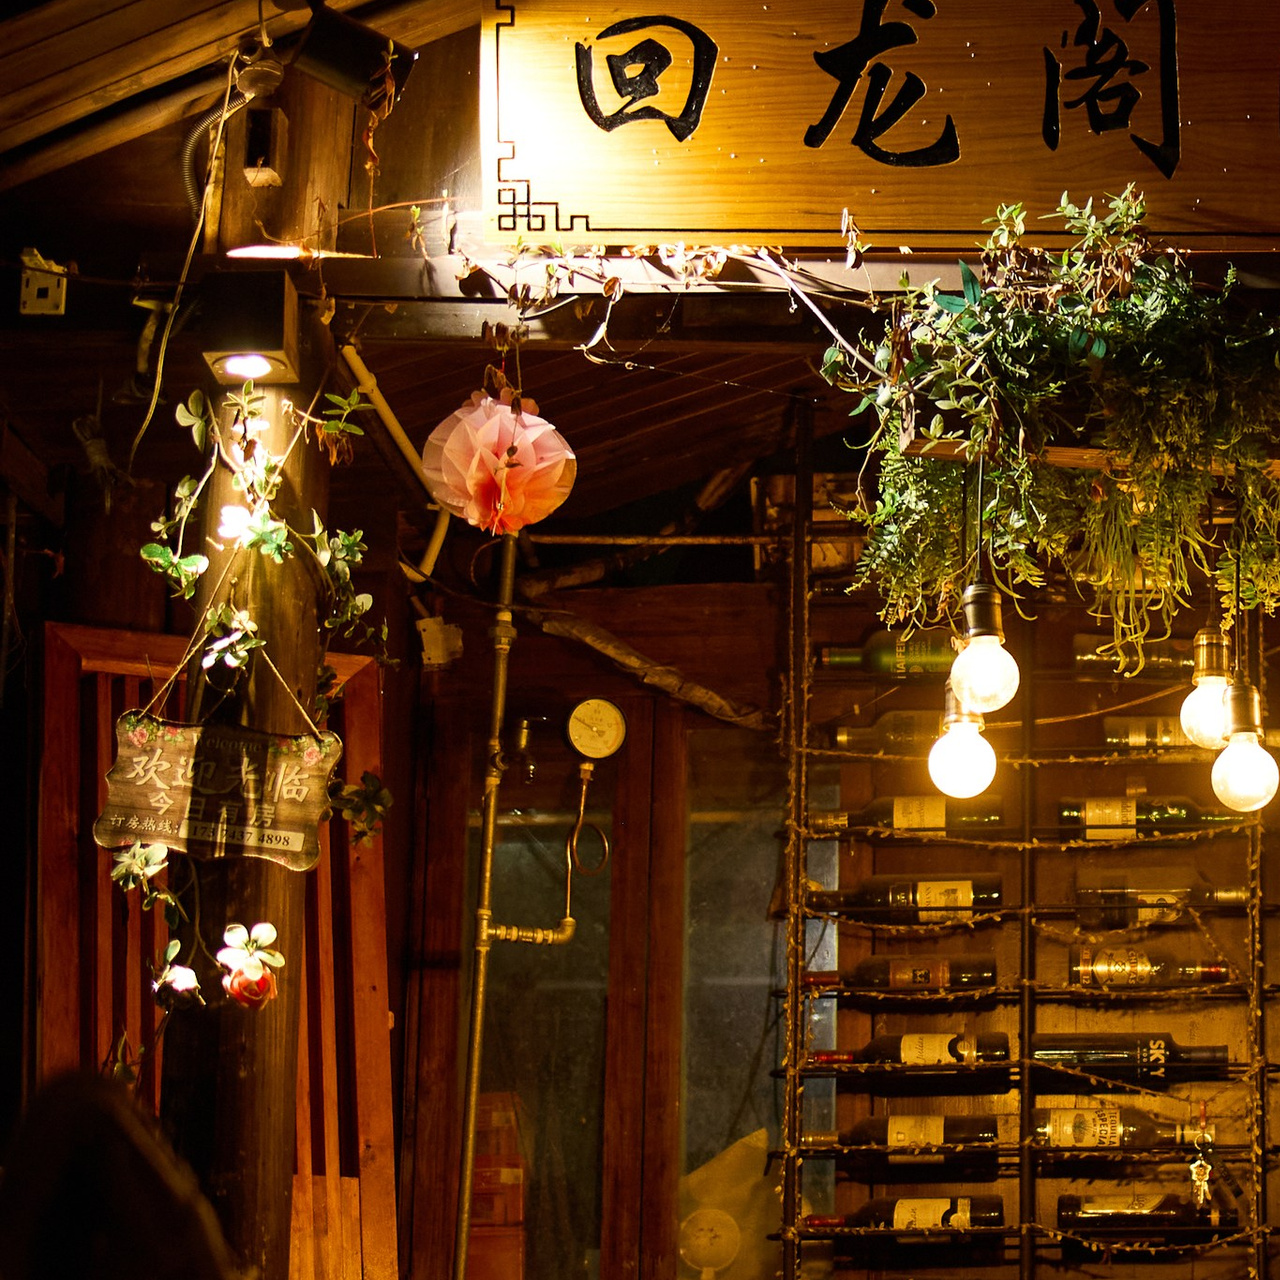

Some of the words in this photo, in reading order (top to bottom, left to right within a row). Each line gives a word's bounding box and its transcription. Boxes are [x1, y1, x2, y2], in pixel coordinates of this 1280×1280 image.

[126, 747, 310, 803] 欢迎光临
[150, 792, 276, 827] 今日有房
[258, 833, 290, 846] 4898
[1095, 1109, 1108, 1147] ESPECIA
[1108, 1112, 1117, 1146] TEQUILA
